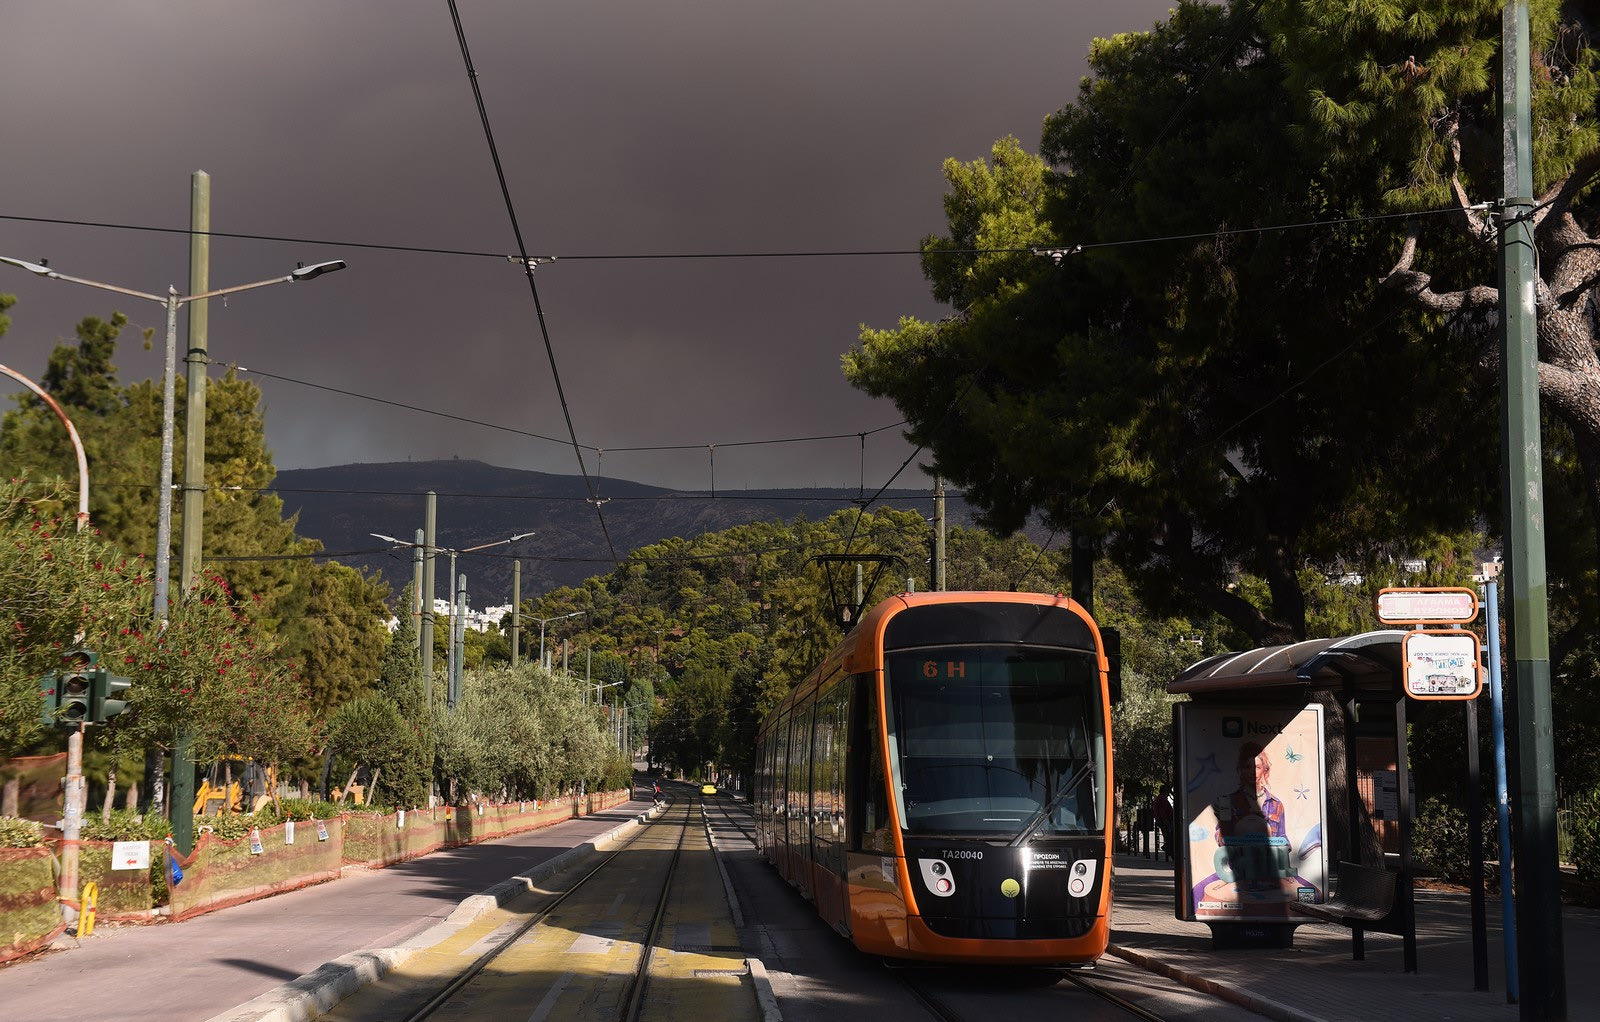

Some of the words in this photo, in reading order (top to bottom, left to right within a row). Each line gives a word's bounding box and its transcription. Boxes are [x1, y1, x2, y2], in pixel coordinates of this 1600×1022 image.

[923, 660, 938, 678] 6
[1247, 721, 1283, 735] Next
[942, 850, 983, 860] TA20040
